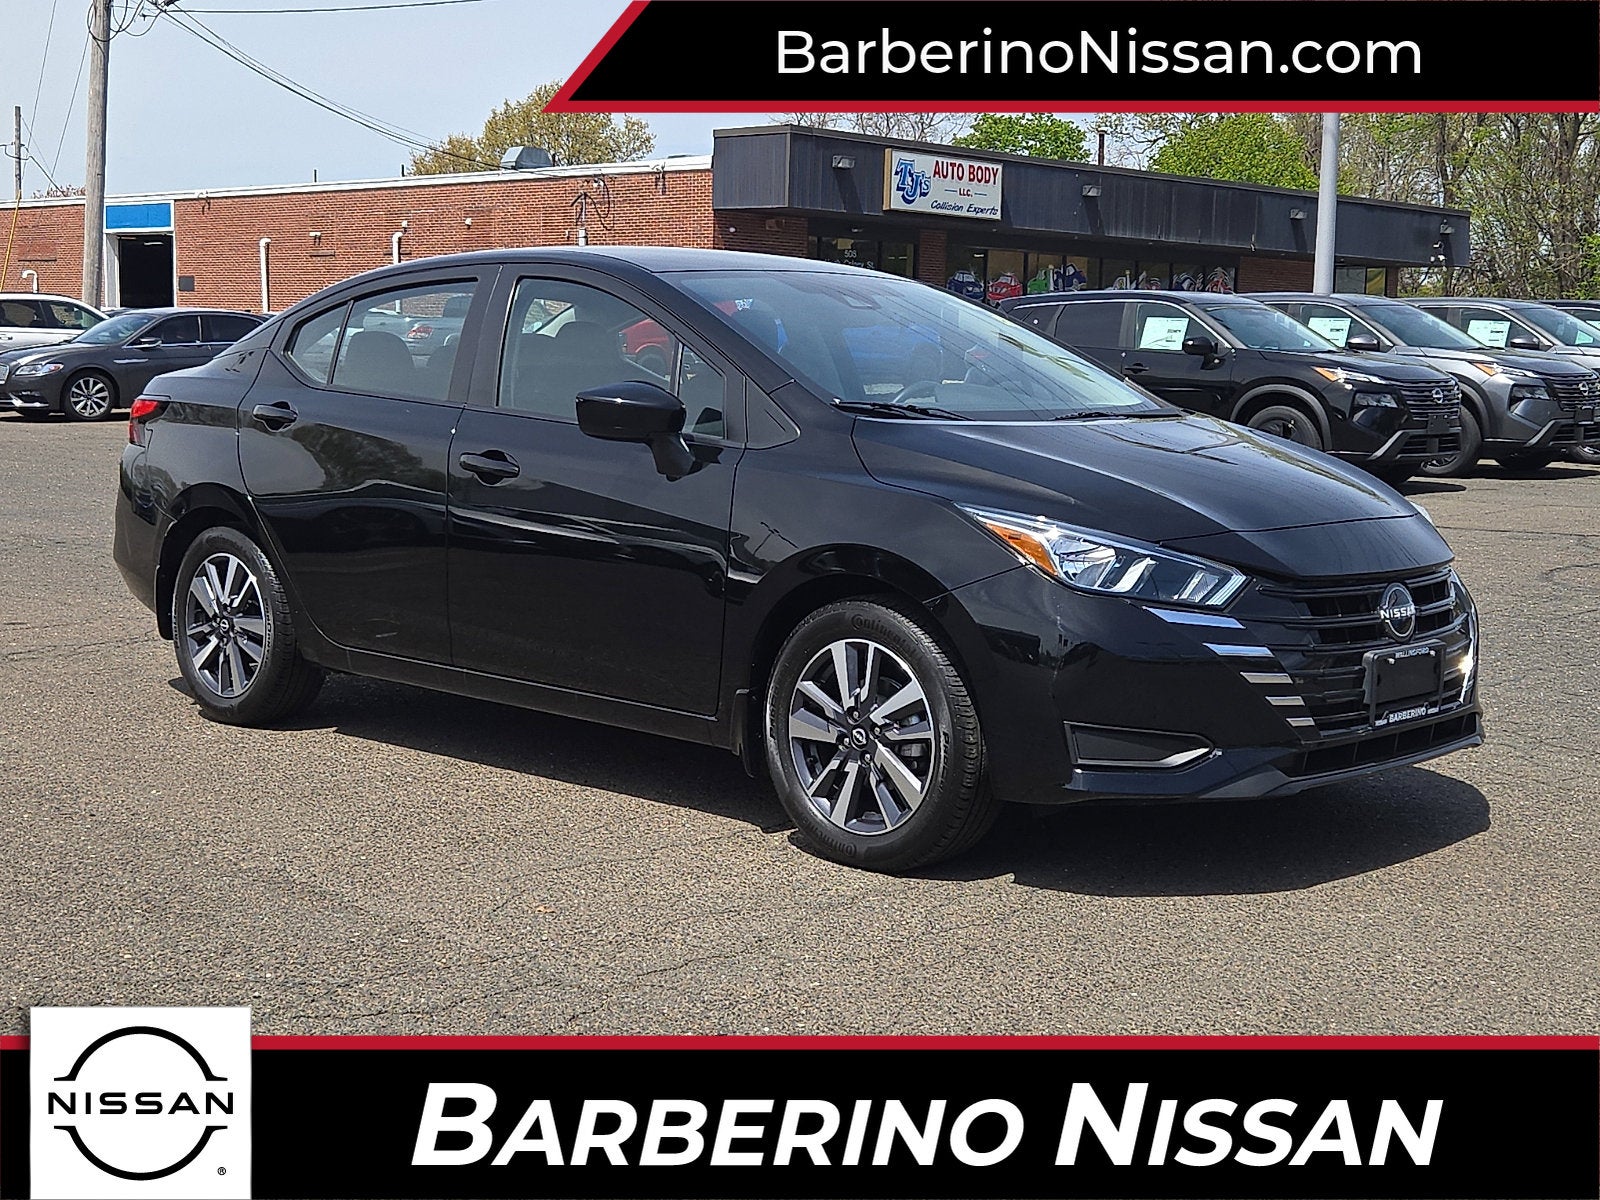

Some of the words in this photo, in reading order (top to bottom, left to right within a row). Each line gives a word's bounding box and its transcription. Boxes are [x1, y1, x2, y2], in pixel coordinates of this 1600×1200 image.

[933, 160, 965, 182] AUTO
[968, 164, 999, 185] BODY
[930, 200, 964, 212] Collision
[966, 203, 999, 216] Experts
[1389, 707, 1427, 722] BARBERINO
